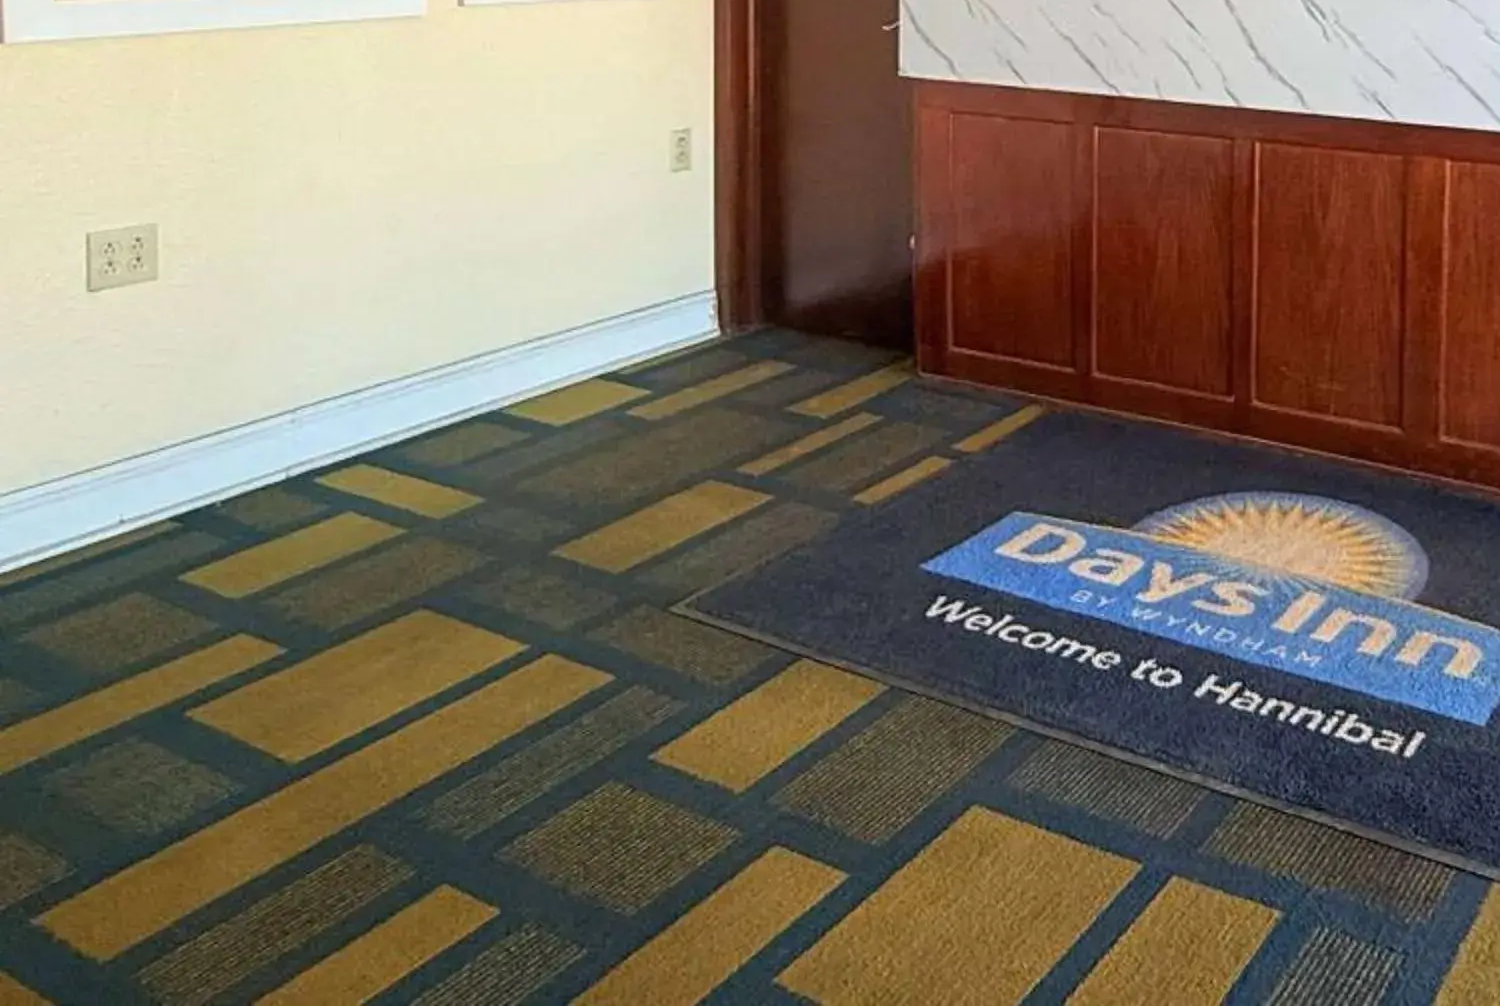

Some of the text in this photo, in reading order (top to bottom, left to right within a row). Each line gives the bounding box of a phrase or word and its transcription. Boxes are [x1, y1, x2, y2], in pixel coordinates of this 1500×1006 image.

[924, 594, 1426, 760] Welcome to Hannibal
[995, 522, 1484, 680] Days Inn
[1070, 590, 1322, 668] BY WYNDHAM
